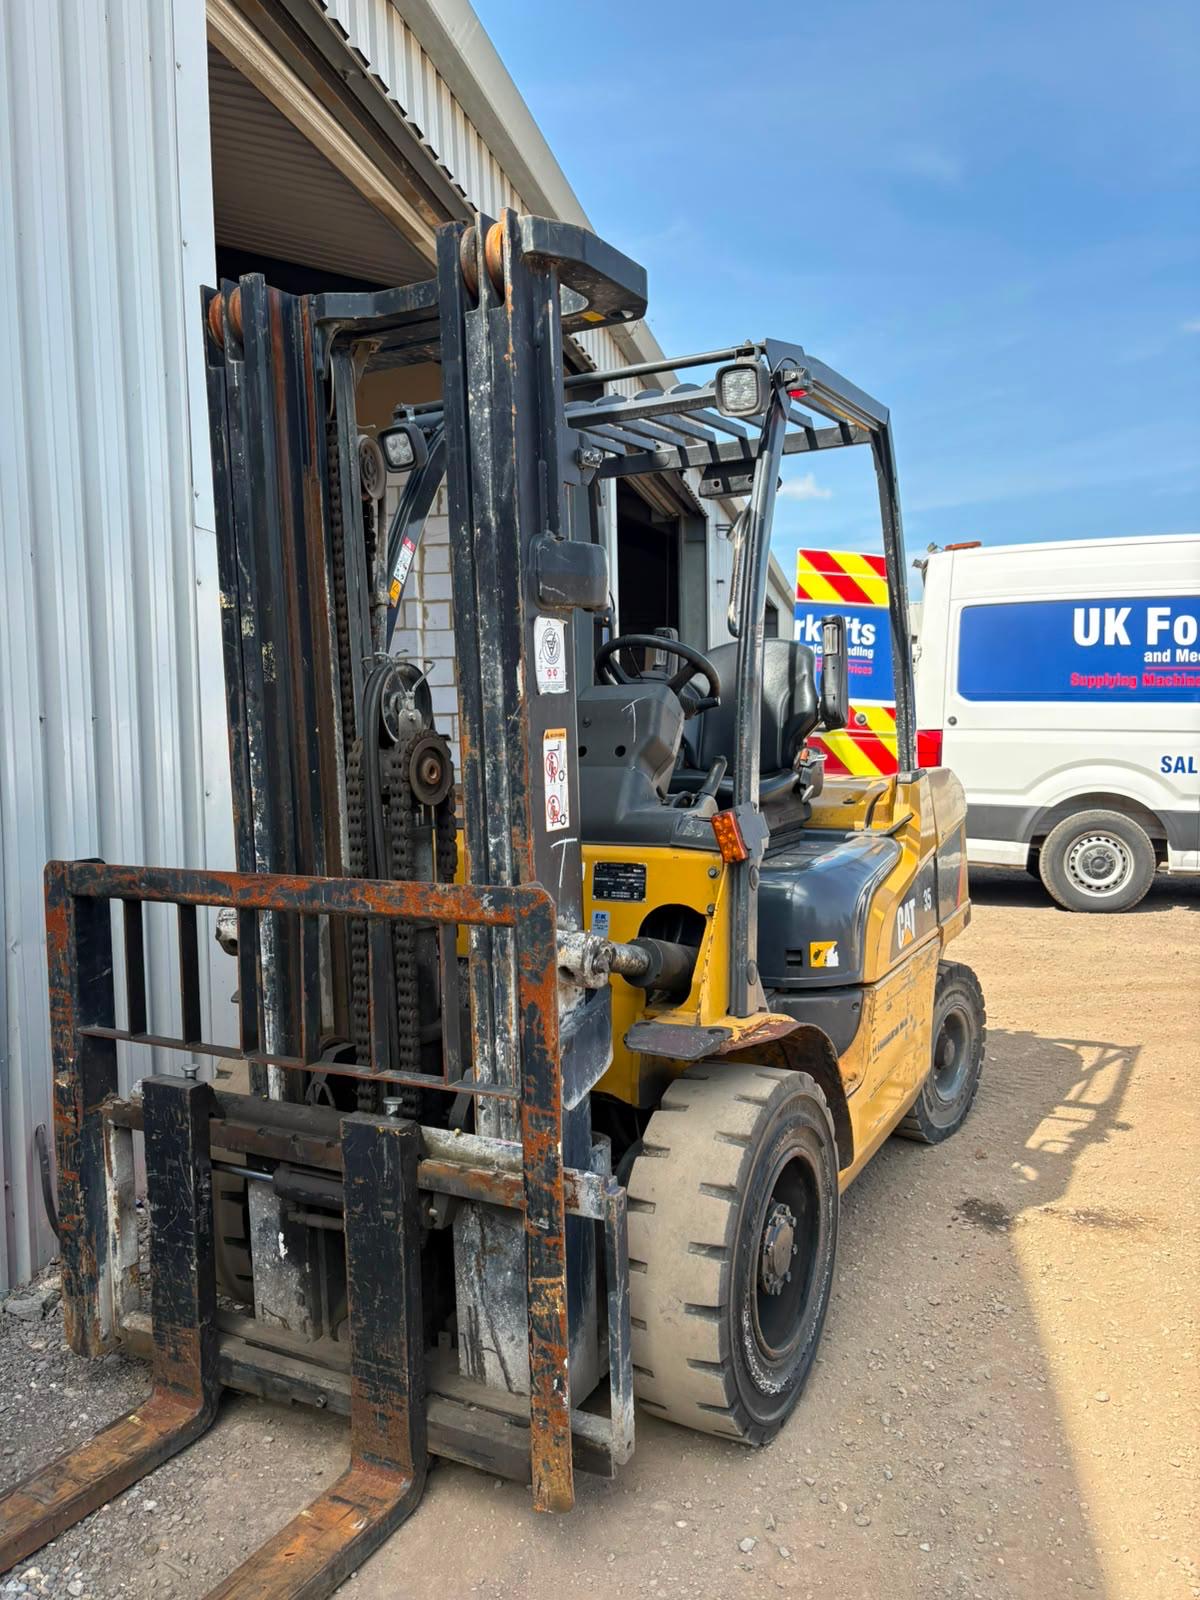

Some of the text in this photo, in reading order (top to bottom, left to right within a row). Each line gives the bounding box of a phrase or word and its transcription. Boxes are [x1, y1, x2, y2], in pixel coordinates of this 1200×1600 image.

[1073, 607, 1198, 646] UK Fo
[1143, 648, 1171, 662] and
[1071, 672, 1137, 688] Supplying
[1160, 755, 1198, 774] SAL
[897, 887, 932, 949] CAT 35
